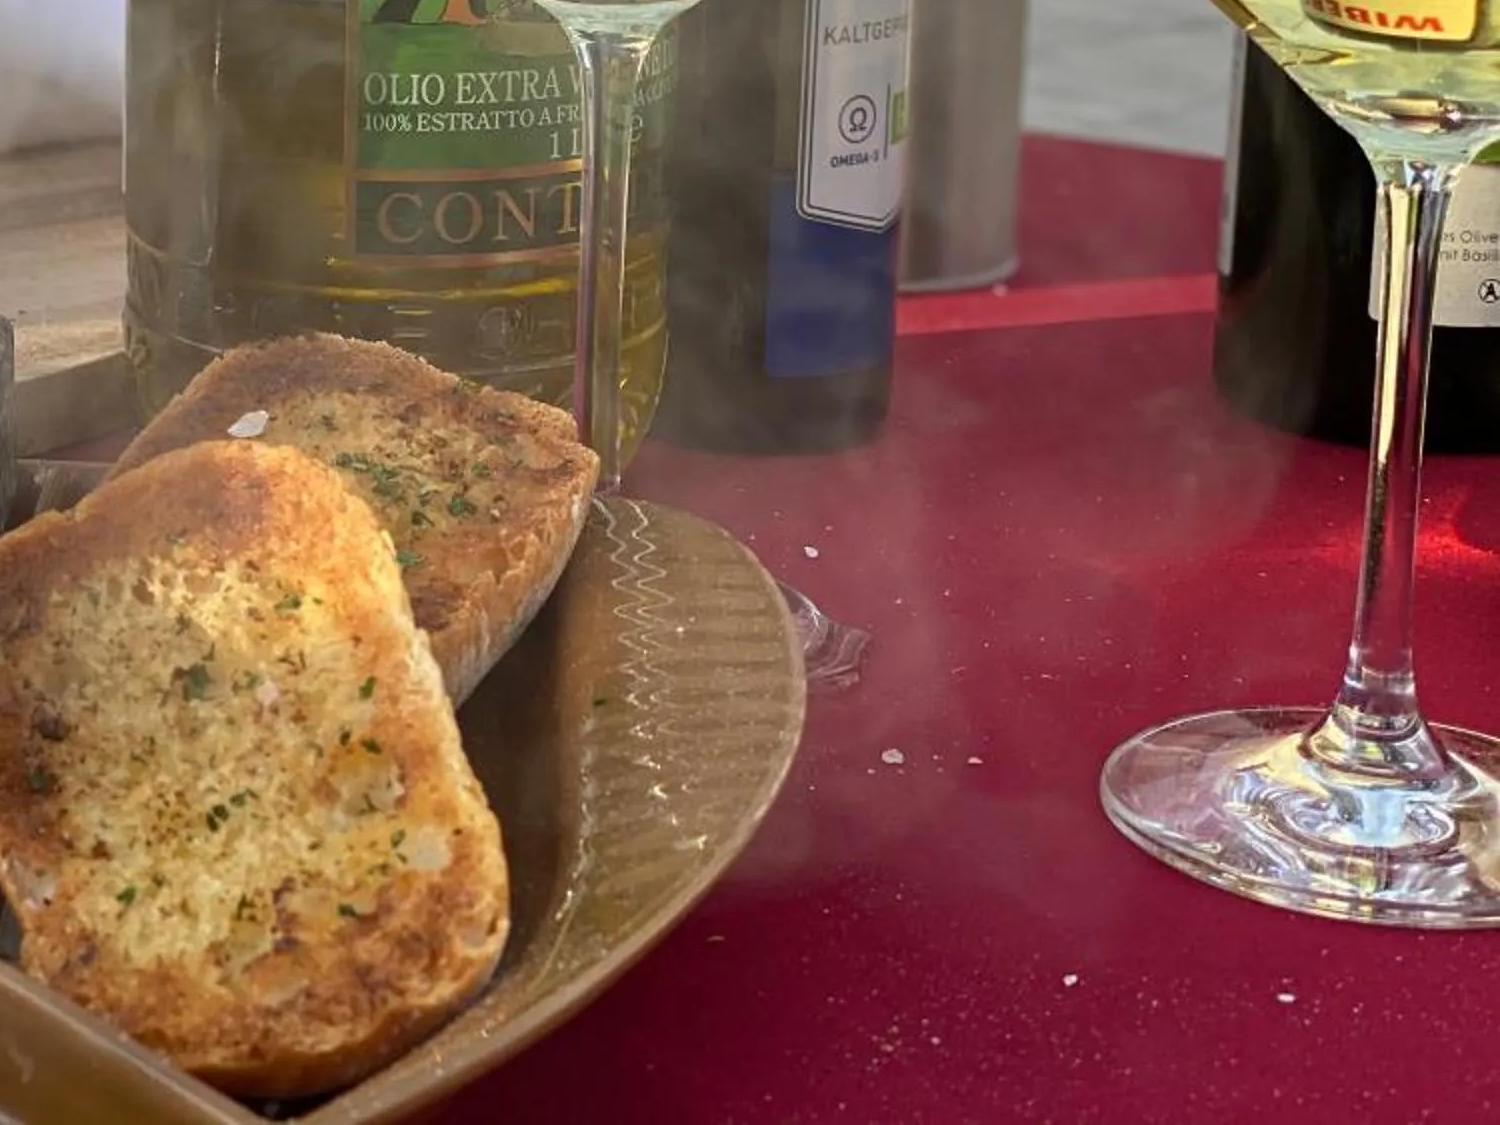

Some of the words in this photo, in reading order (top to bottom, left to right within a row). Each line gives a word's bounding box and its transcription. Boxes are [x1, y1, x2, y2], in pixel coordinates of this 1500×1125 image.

[364, 71, 446, 106] OLIO
[455, 67, 561, 104] EXTRA
[364, 111, 412, 132] 100%
[417, 107, 535, 132] ESTRATTO
[538, 106, 552, 126] A
